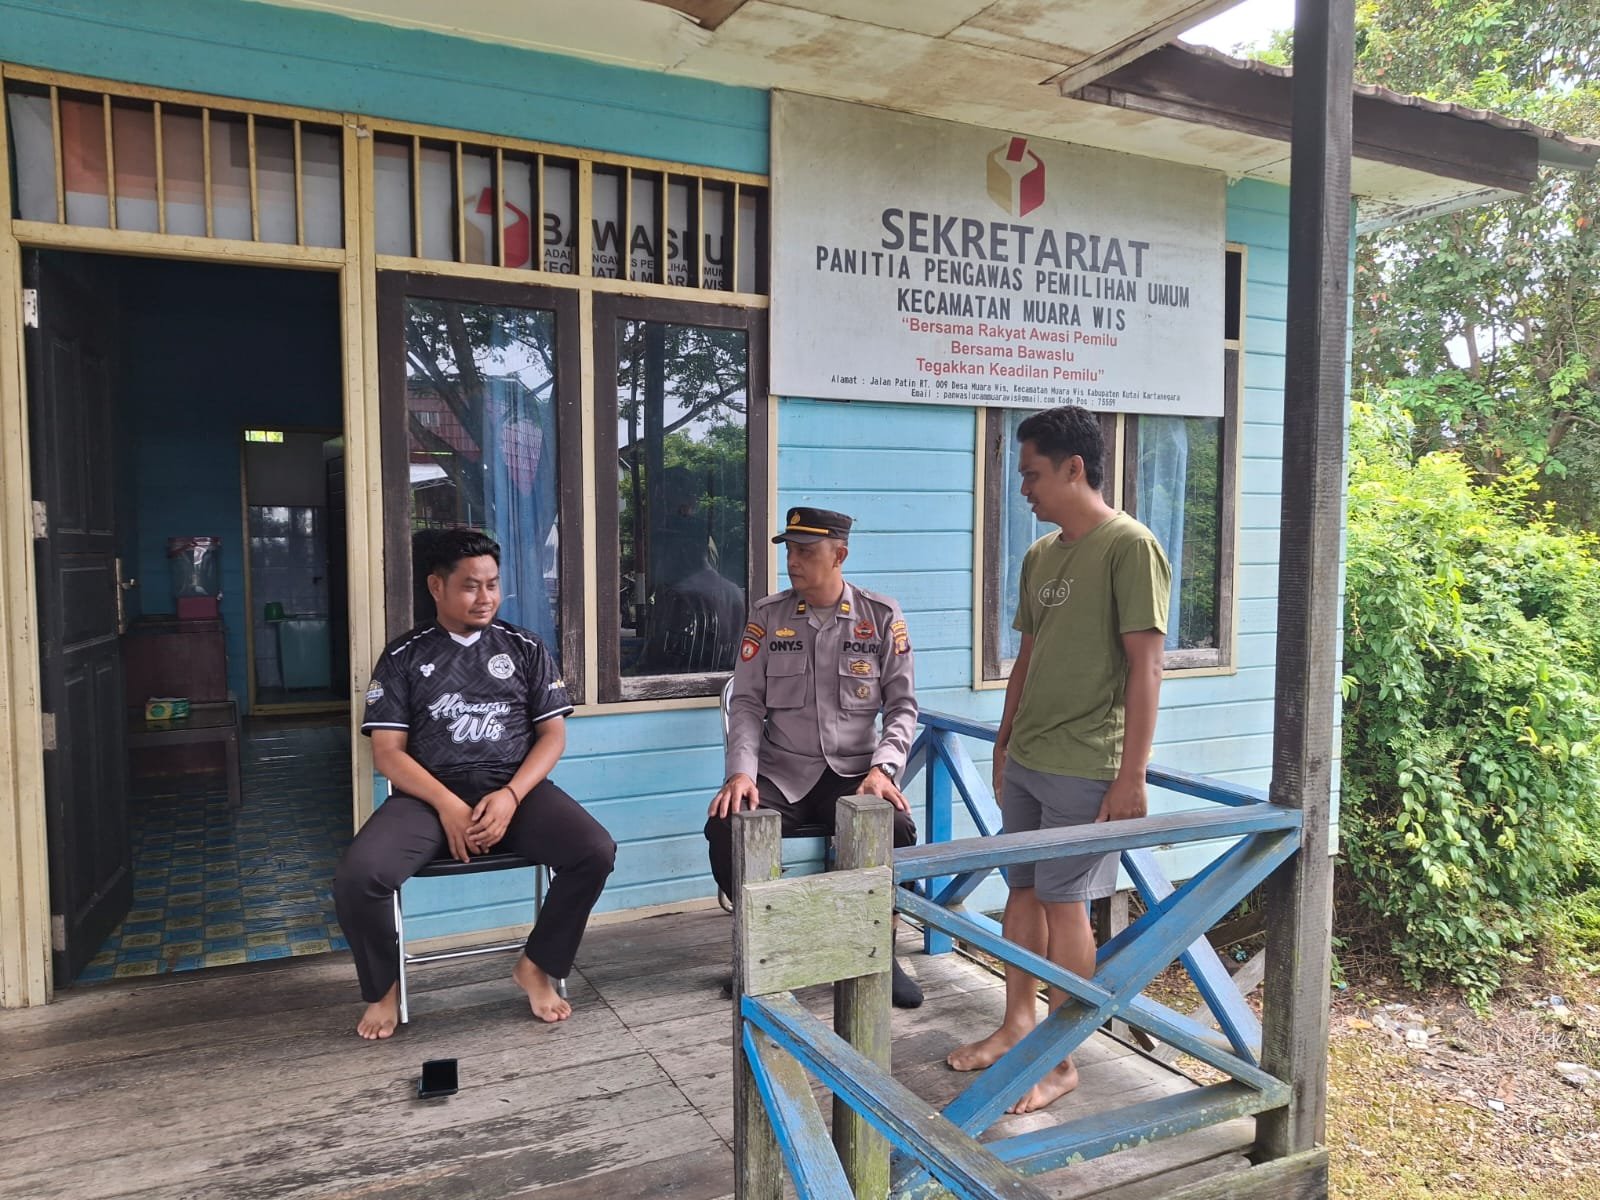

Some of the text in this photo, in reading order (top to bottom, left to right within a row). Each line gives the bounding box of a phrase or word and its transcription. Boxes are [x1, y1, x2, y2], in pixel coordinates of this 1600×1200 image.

[881, 208, 1150, 278] SEKRETARIAT
[816, 245, 1190, 308] PANITIA PENGAWAS PEMILIHAN UMUM
[897, 287, 1126, 331] KECAMATAN MUARA WIS
[978, 323, 1026, 342] Rakyat
[1030, 327, 1070, 344] Awasi
[1073, 331, 1118, 347] Pemilu
[951, 340, 1075, 362] Bersama Bawaslu
[916, 357, 985, 376] Tegakkan
[989, 362, 1049, 379] Keadilan
[831, 375, 857, 385] Alamat
[869, 377, 892, 387] Jalan
[894, 378, 916, 388] Patin
[935, 380, 948, 389] 009
[951, 381, 968, 390] Desa
[971, 382, 992, 391] Muara
[1013, 384, 1048, 394] Kecamatan
[1050, 387, 1070, 396] Muara
[1072, 388, 1084, 396] Wis
[1087, 388, 1120, 399] Kabupaten
[1122, 390, 1140, 399] Kutai
[1142, 391, 1181, 402] Kartanegara
[911, 388, 931, 398] Email
[1058, 396, 1073, 405] Kode
[1076, 397, 1088, 406] Pos
[843, 641, 881, 654] POLRI
[447, 710, 504, 742] Wis
